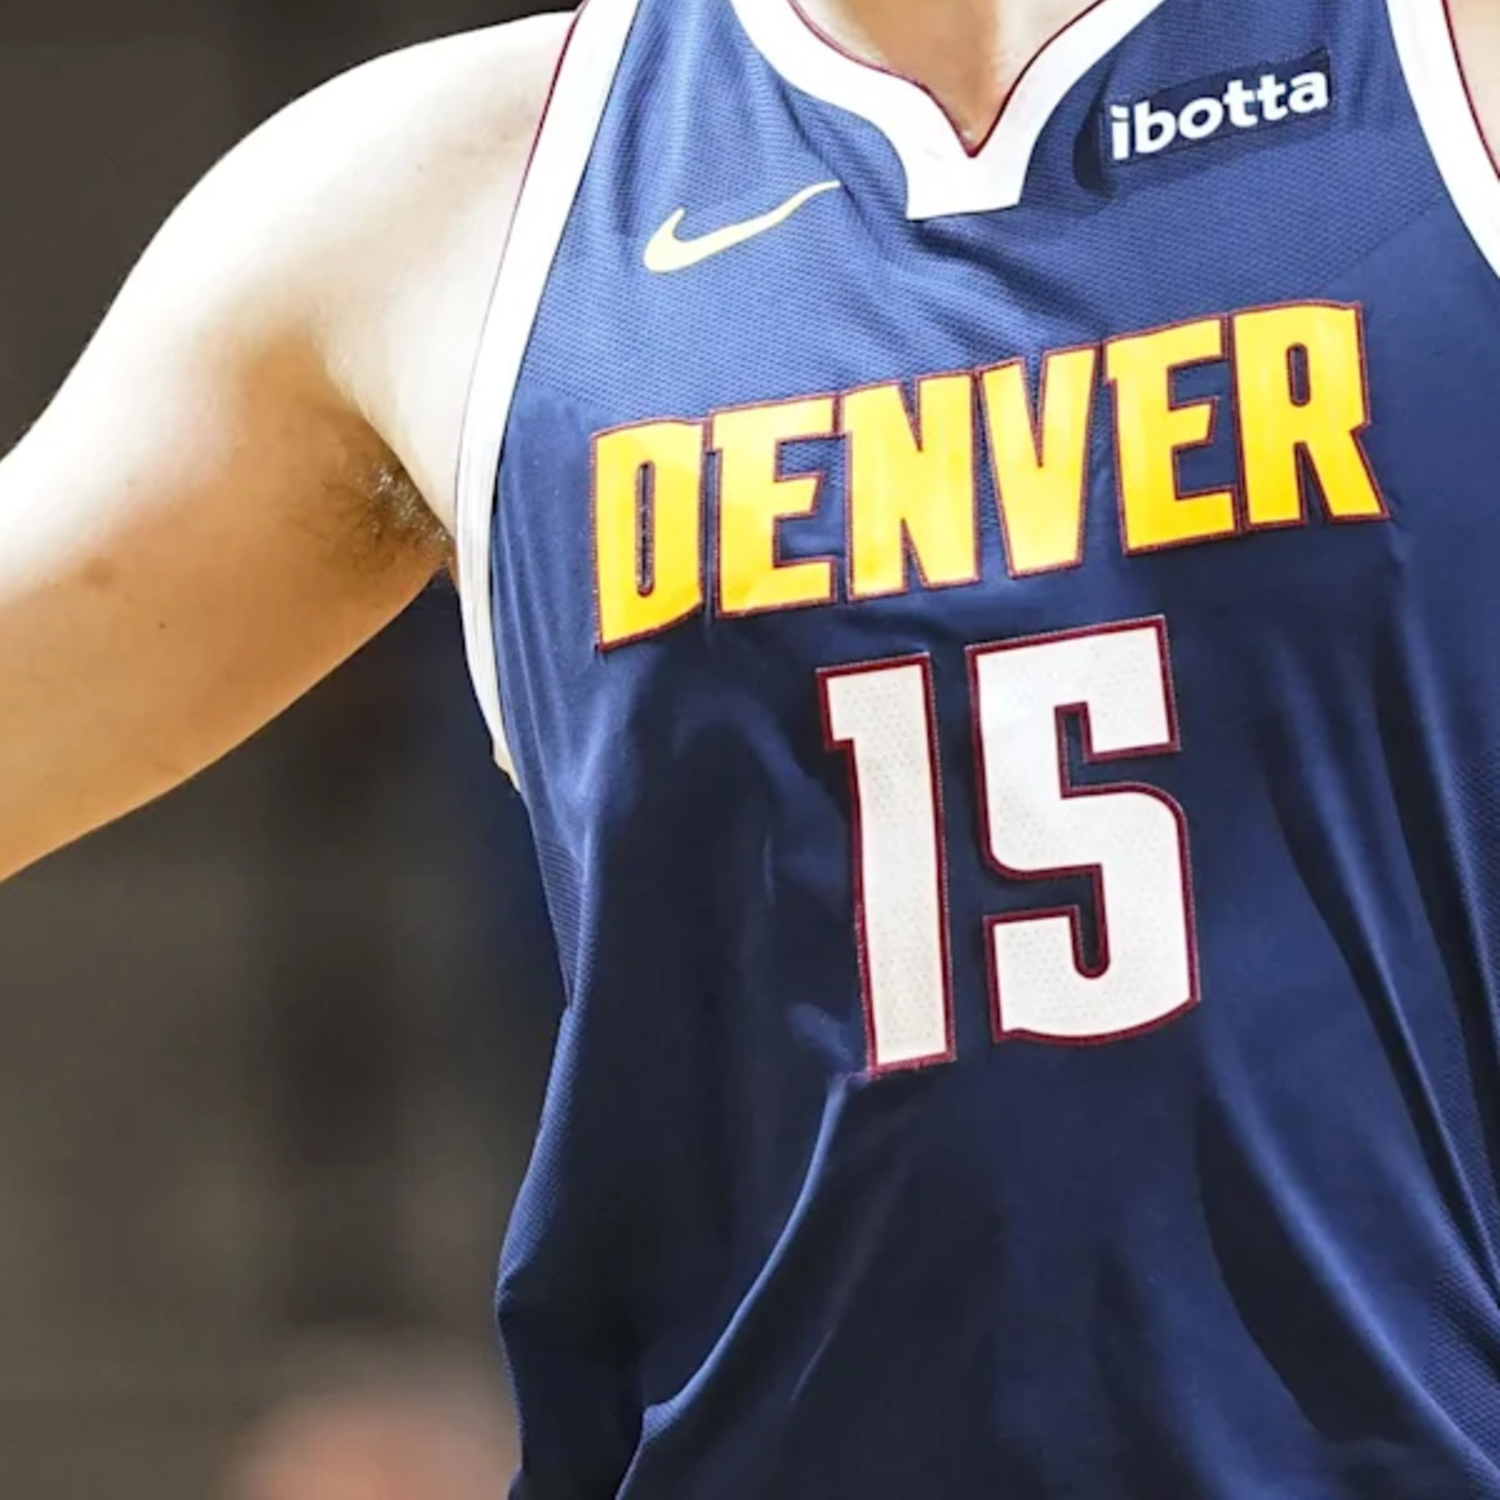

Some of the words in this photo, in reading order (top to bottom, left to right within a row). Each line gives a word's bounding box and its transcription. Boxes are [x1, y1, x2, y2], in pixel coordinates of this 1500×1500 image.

[1109, 70, 1331, 161] ibotta
[591, 300, 1388, 652] DENVER
[817, 616, 1199, 1078] 15
